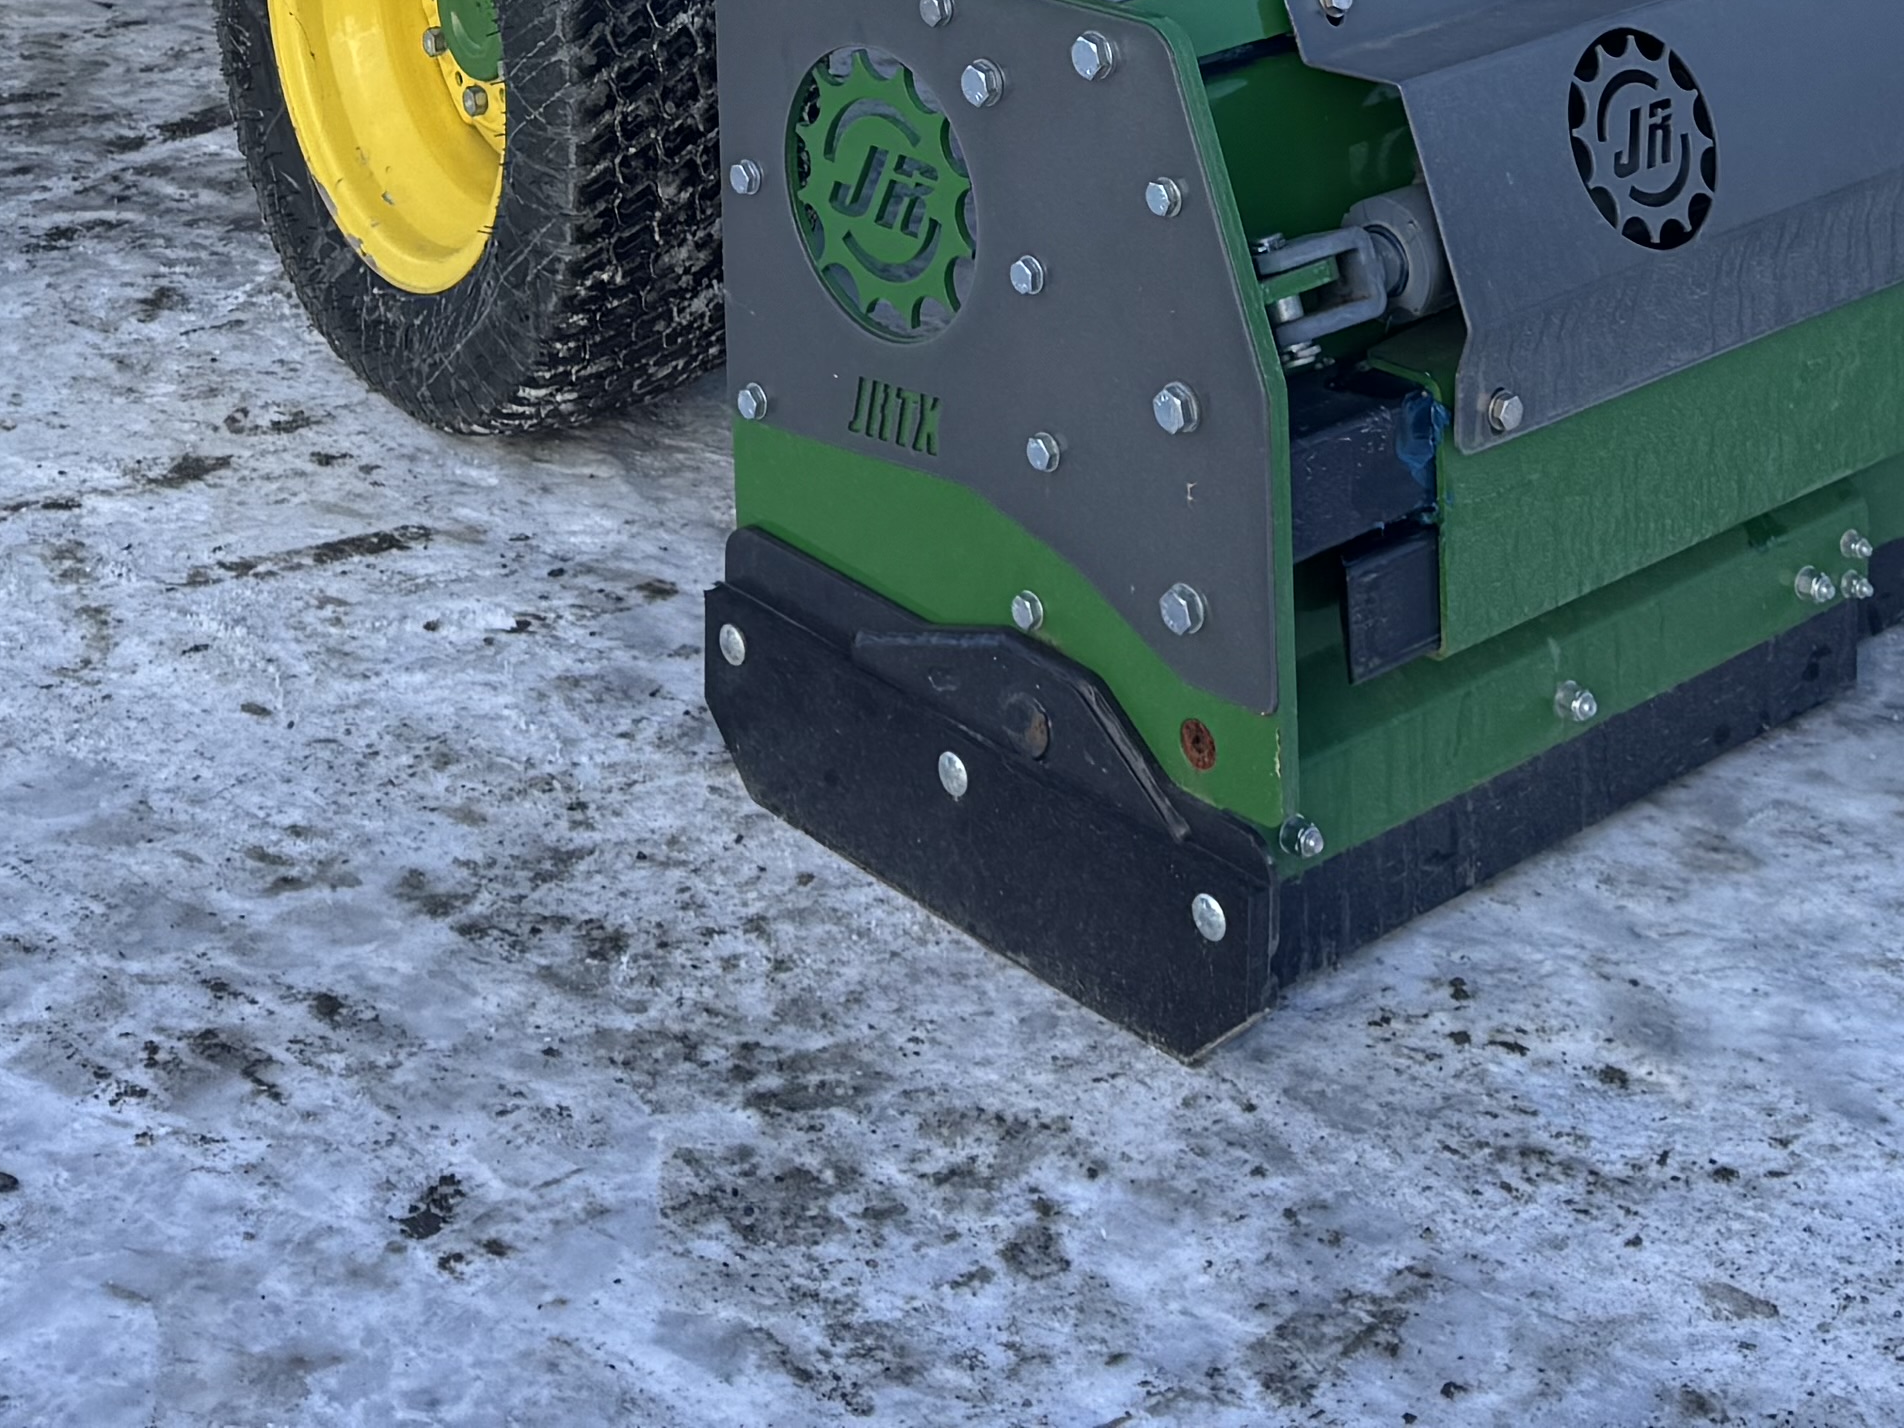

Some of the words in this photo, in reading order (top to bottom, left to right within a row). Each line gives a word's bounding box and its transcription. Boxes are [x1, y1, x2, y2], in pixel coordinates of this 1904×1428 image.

[1613, 97, 1673, 179] JR
[828, 144, 939, 239] JR
[847, 375, 942, 457] JRTX
